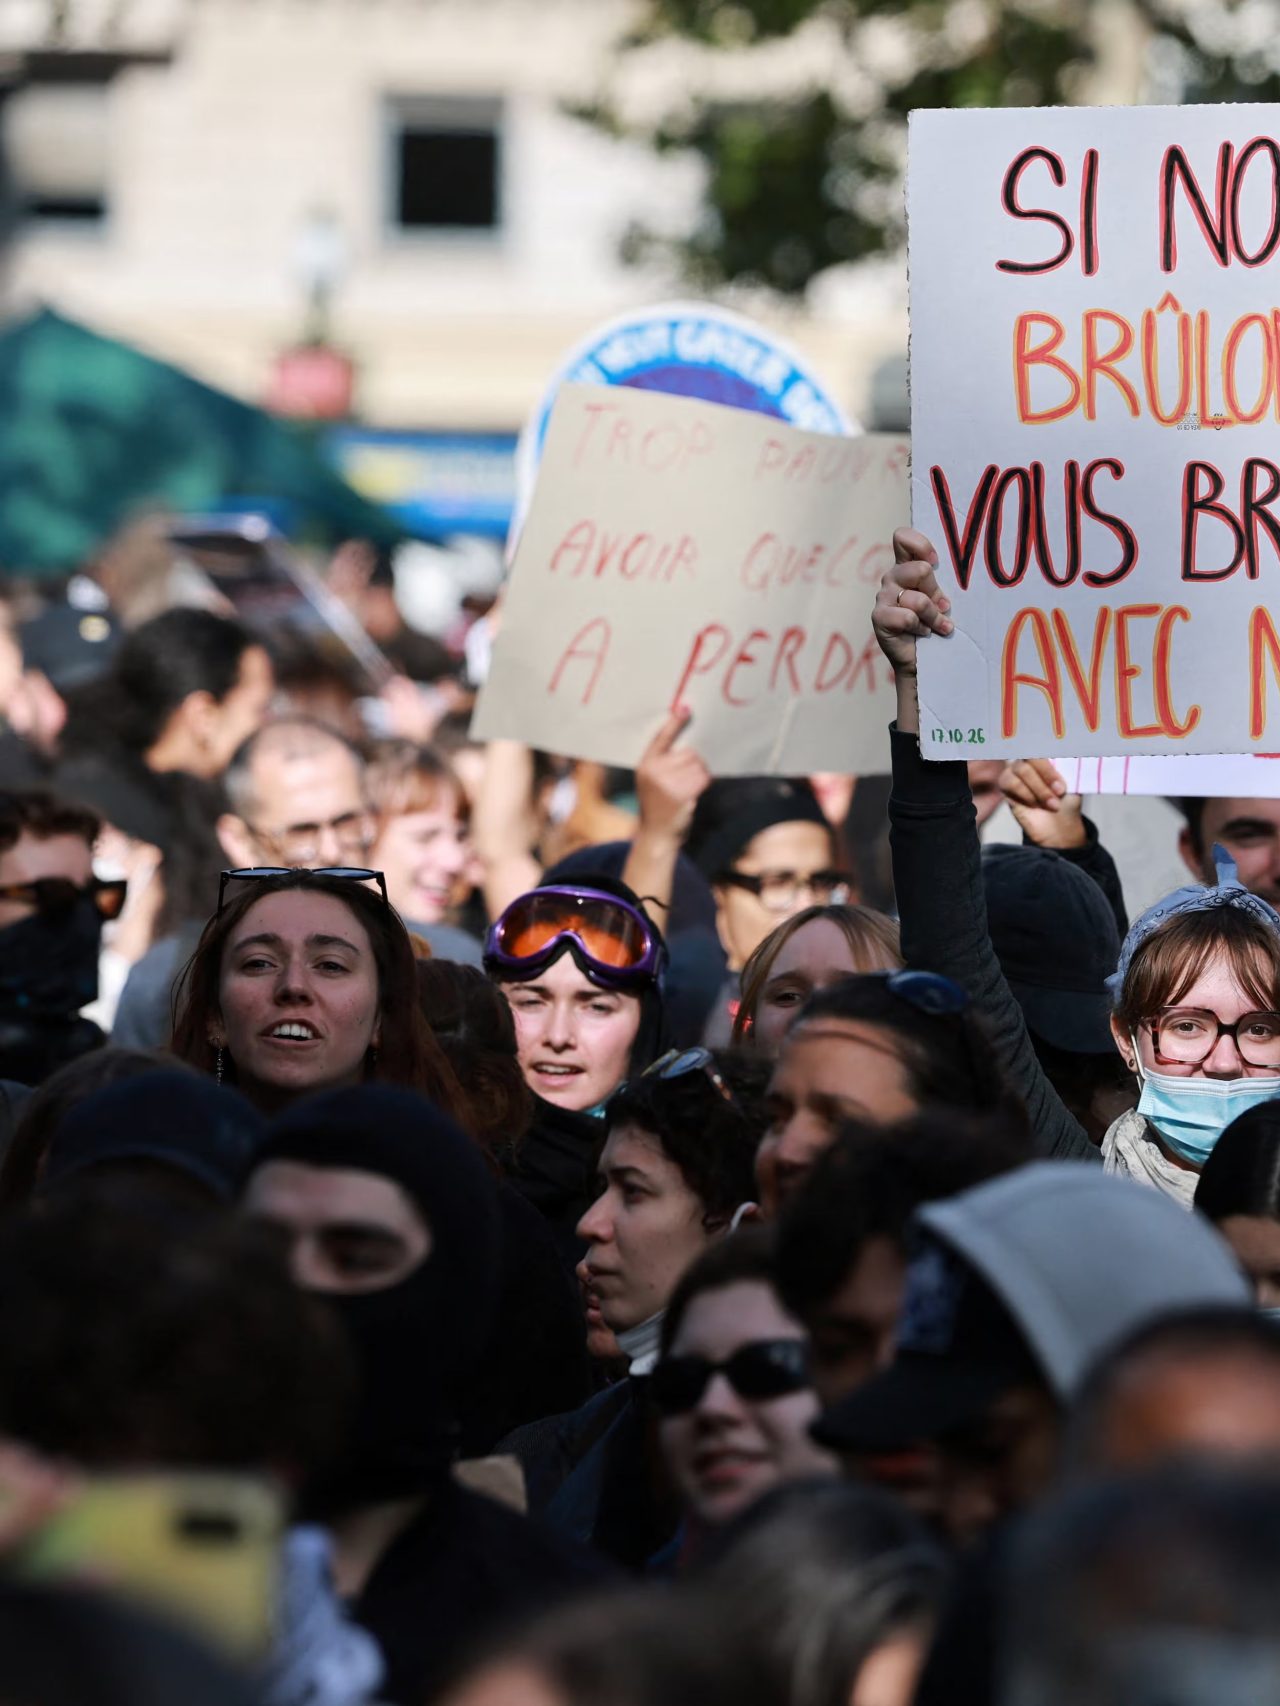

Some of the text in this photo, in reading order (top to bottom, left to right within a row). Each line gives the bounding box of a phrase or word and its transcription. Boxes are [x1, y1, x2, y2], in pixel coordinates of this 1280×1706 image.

[996, 146, 1099, 276] SI
[572, 403, 716, 473] TROP
[549, 518, 699, 582] AVOIR
[930, 457, 1139, 590] VOUS
[547, 616, 612, 706] A
[1002, 604, 1201, 739] AVEC
